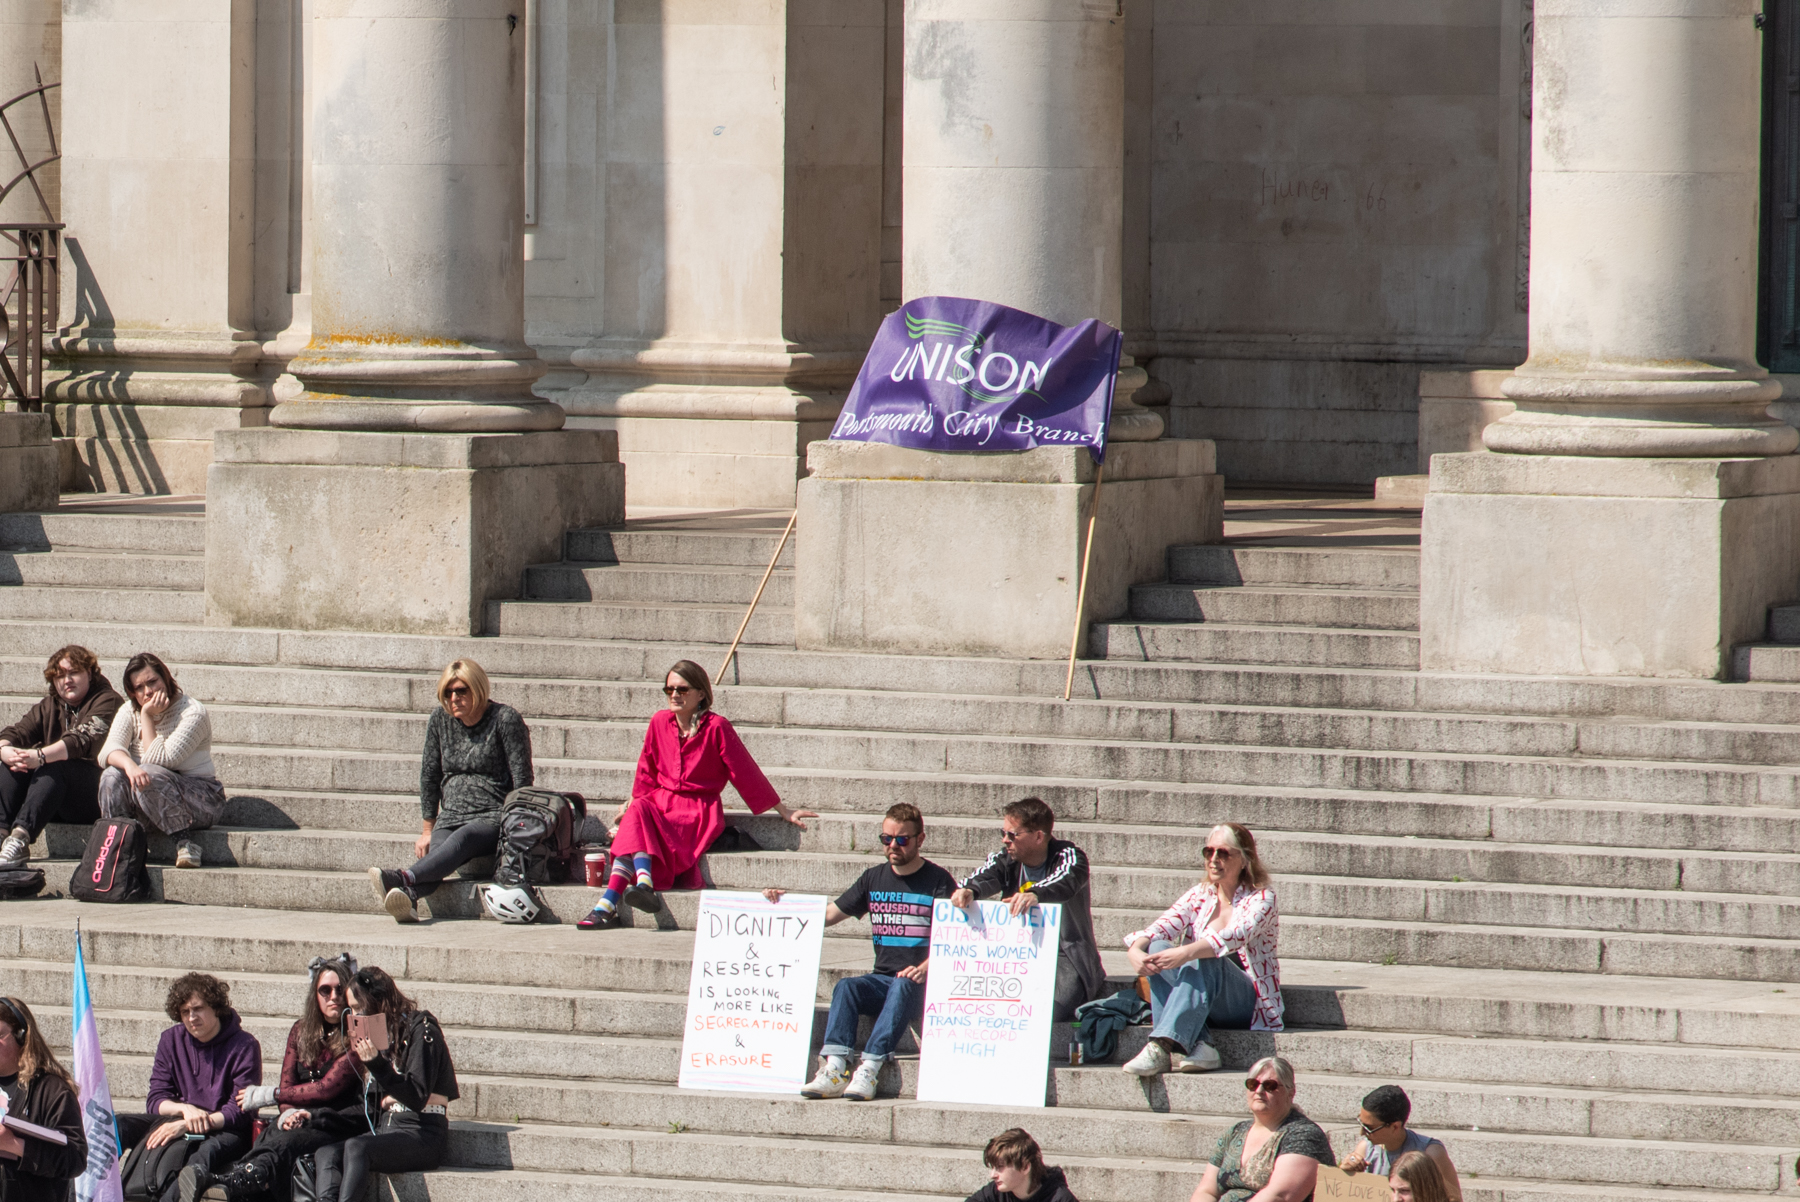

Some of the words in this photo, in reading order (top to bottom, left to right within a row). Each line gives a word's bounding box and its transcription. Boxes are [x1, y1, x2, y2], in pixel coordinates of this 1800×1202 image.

[891, 341, 1052, 394] UNISON
[832, 404, 934, 438] Portsmouth
[943, 410, 1000, 446] City
[92, 825, 118, 883] adidas
[869, 891, 902, 902] YOU'RE
[869, 903, 910, 914] FOCUSED
[935, 901, 969, 923] CIS
[981, 904, 1057, 927] WOMEN
[871, 913, 883, 924] ON
[883, 914, 902, 924] THE
[872, 925, 905, 936] WRONG
[933, 926, 1005, 942] ATTACKED
[1017, 929, 1036, 943] BY
[746, 942, 759, 960] &
[933, 944, 977, 957] TRANS
[987, 945, 1038, 959] WOMEN
[953, 960, 966, 972] IN
[975, 961, 1028, 974] TOILETS
[700, 986, 715, 998] IS
[726, 986, 780, 999] LOOKING
[951, 976, 1022, 998] ZERO
[714, 1001, 752, 1011] MORE
[761, 1002, 793, 1014] LIKE
[926, 1003, 995, 1015] ATTACKS
[1007, 1004, 1032, 1017] ON
[694, 1015, 799, 1033] SEGREGATION
[928, 1015, 971, 1026] TRANS
[978, 1016, 1028, 1030] PEOPLE
[735, 1034, 745, 1048] &
[925, 1029, 944, 1039] AT
[947, 1029, 957, 1038] A
[965, 1029, 1017, 1041] RECORD
[953, 1042, 996, 1058] HIGH
[691, 1052, 773, 1068] ERASURE
[1324, 1176, 1342, 1198] WE
[1349, 1181, 1373, 1199] LOVE
